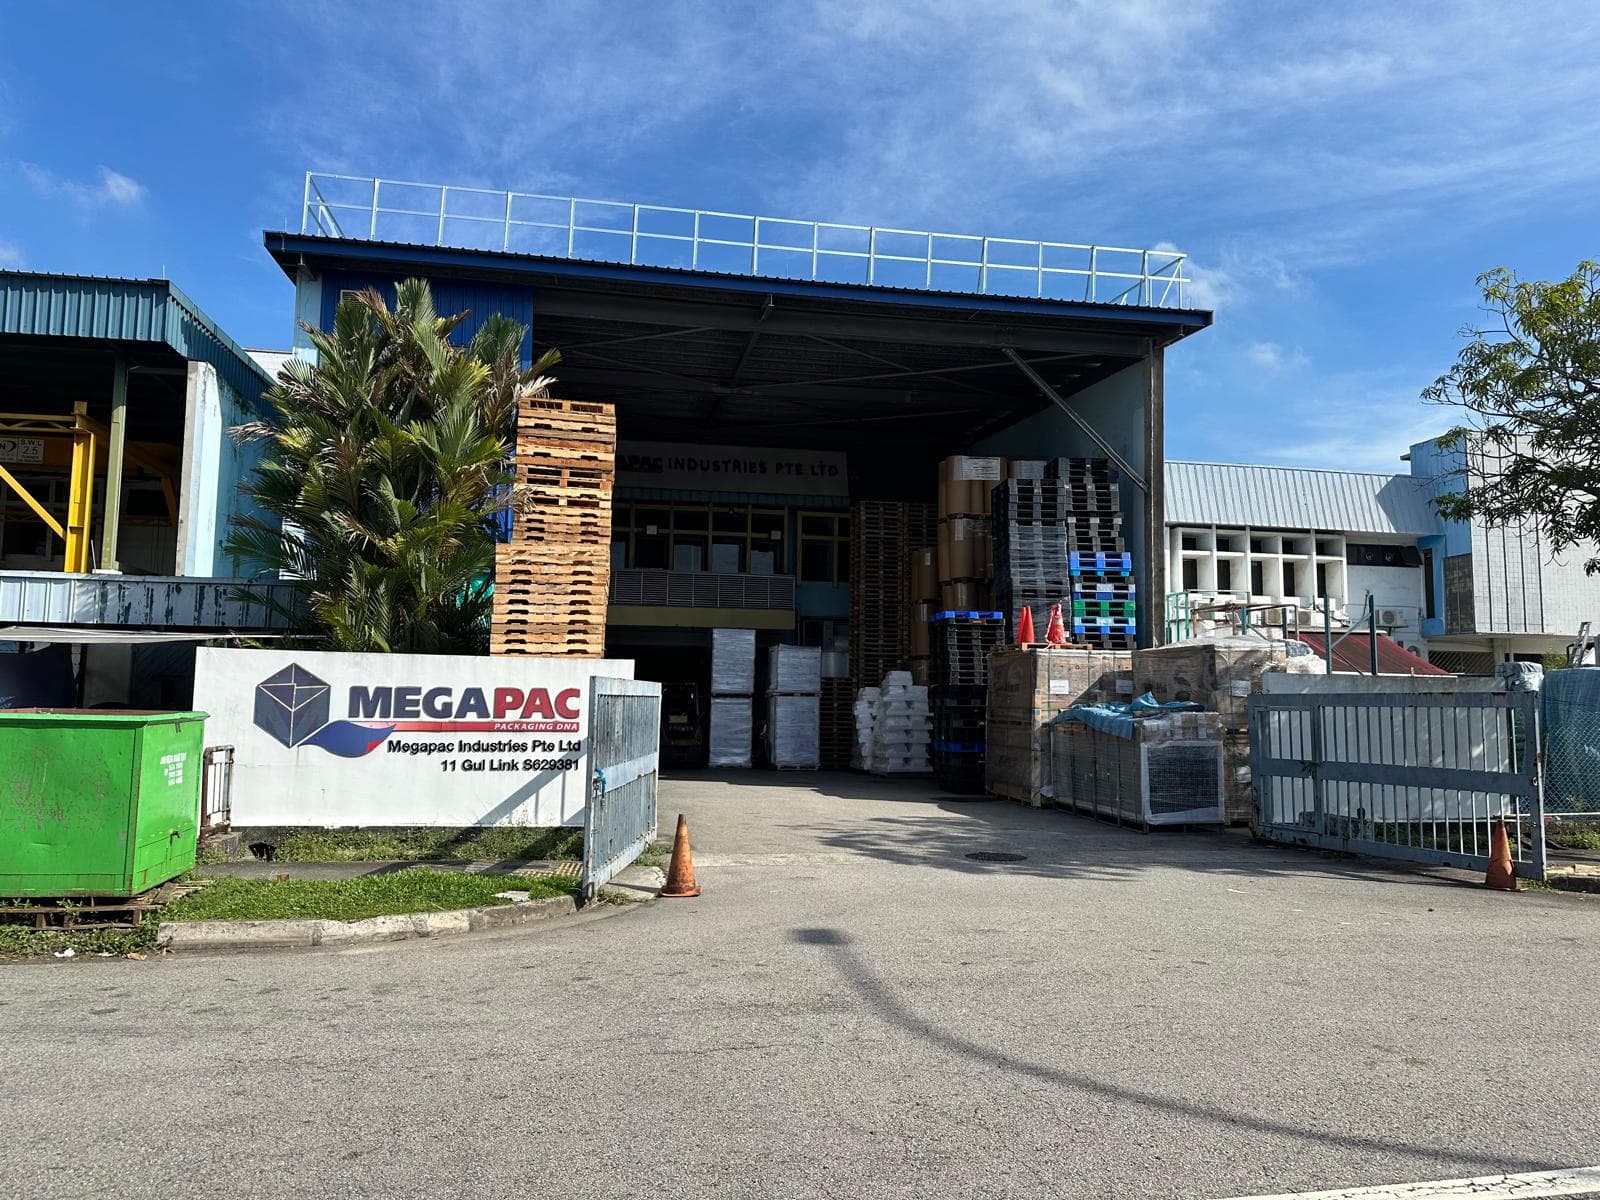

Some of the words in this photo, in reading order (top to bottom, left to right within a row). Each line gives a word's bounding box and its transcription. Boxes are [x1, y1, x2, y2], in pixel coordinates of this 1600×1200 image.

[668, 456, 767, 475] INDUSTRIES
[775, 461, 803, 475] PTE
[810, 461, 839, 477] LTD
[348, 686, 580, 719] MEGAPAC
[387, 740, 454, 755] Megapac
[458, 740, 528, 752] Industries
[532, 740, 555, 752] Pte
[558, 740, 581, 752] Ltd
[440, 760, 456, 772] 11
[461, 759, 485, 772] Gul
[489, 759, 519, 772] Link
[522, 759, 579, 771] S629381
